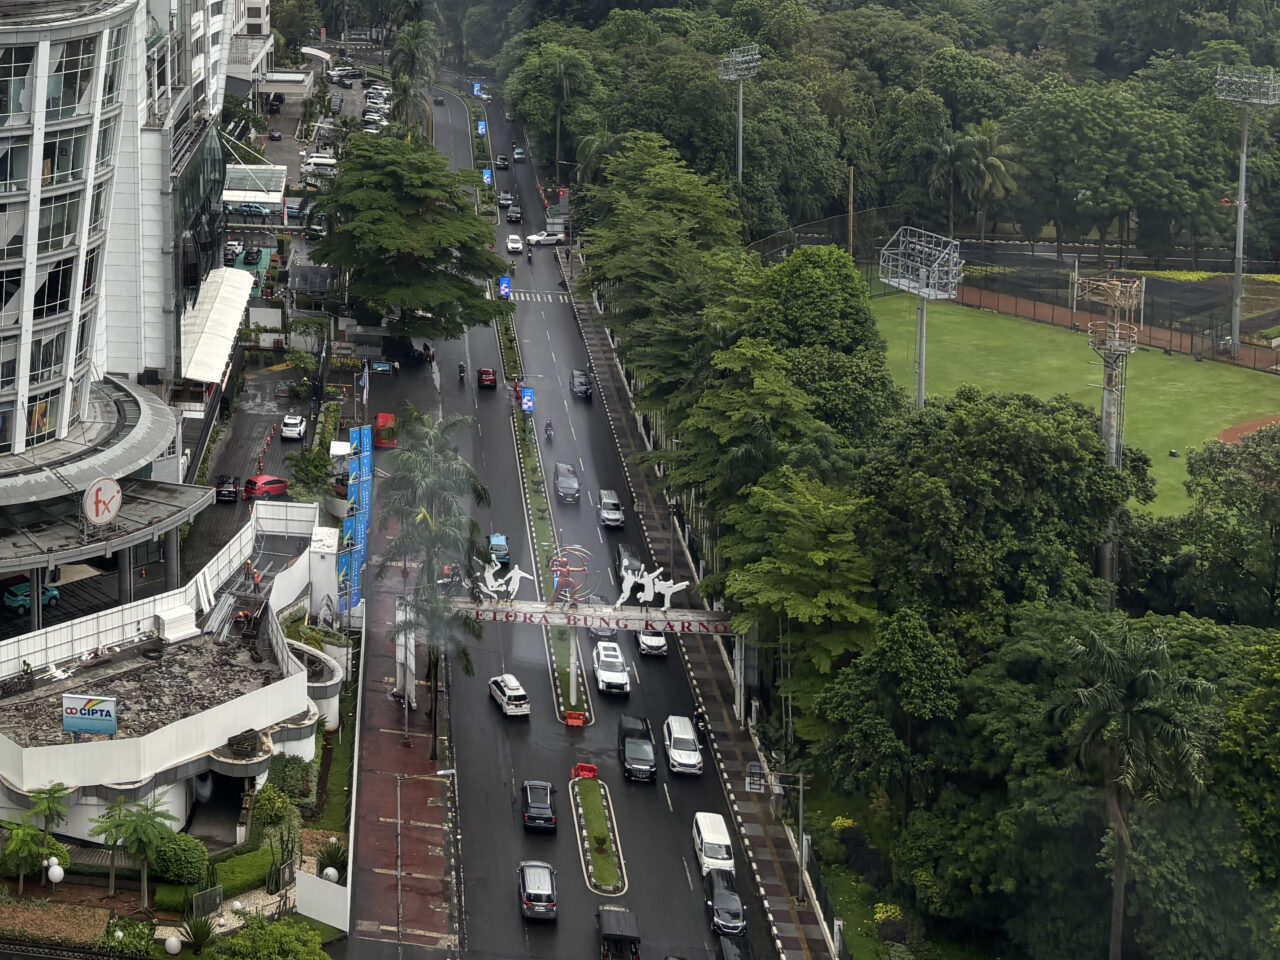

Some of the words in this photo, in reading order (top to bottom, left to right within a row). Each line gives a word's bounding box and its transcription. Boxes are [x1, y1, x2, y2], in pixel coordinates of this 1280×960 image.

[456, 609, 550, 625] ELORA
[566, 615, 628, 630] BUNG
[644, 619, 729, 634] KARNO
[79, 708, 112, 718] CIPTA
